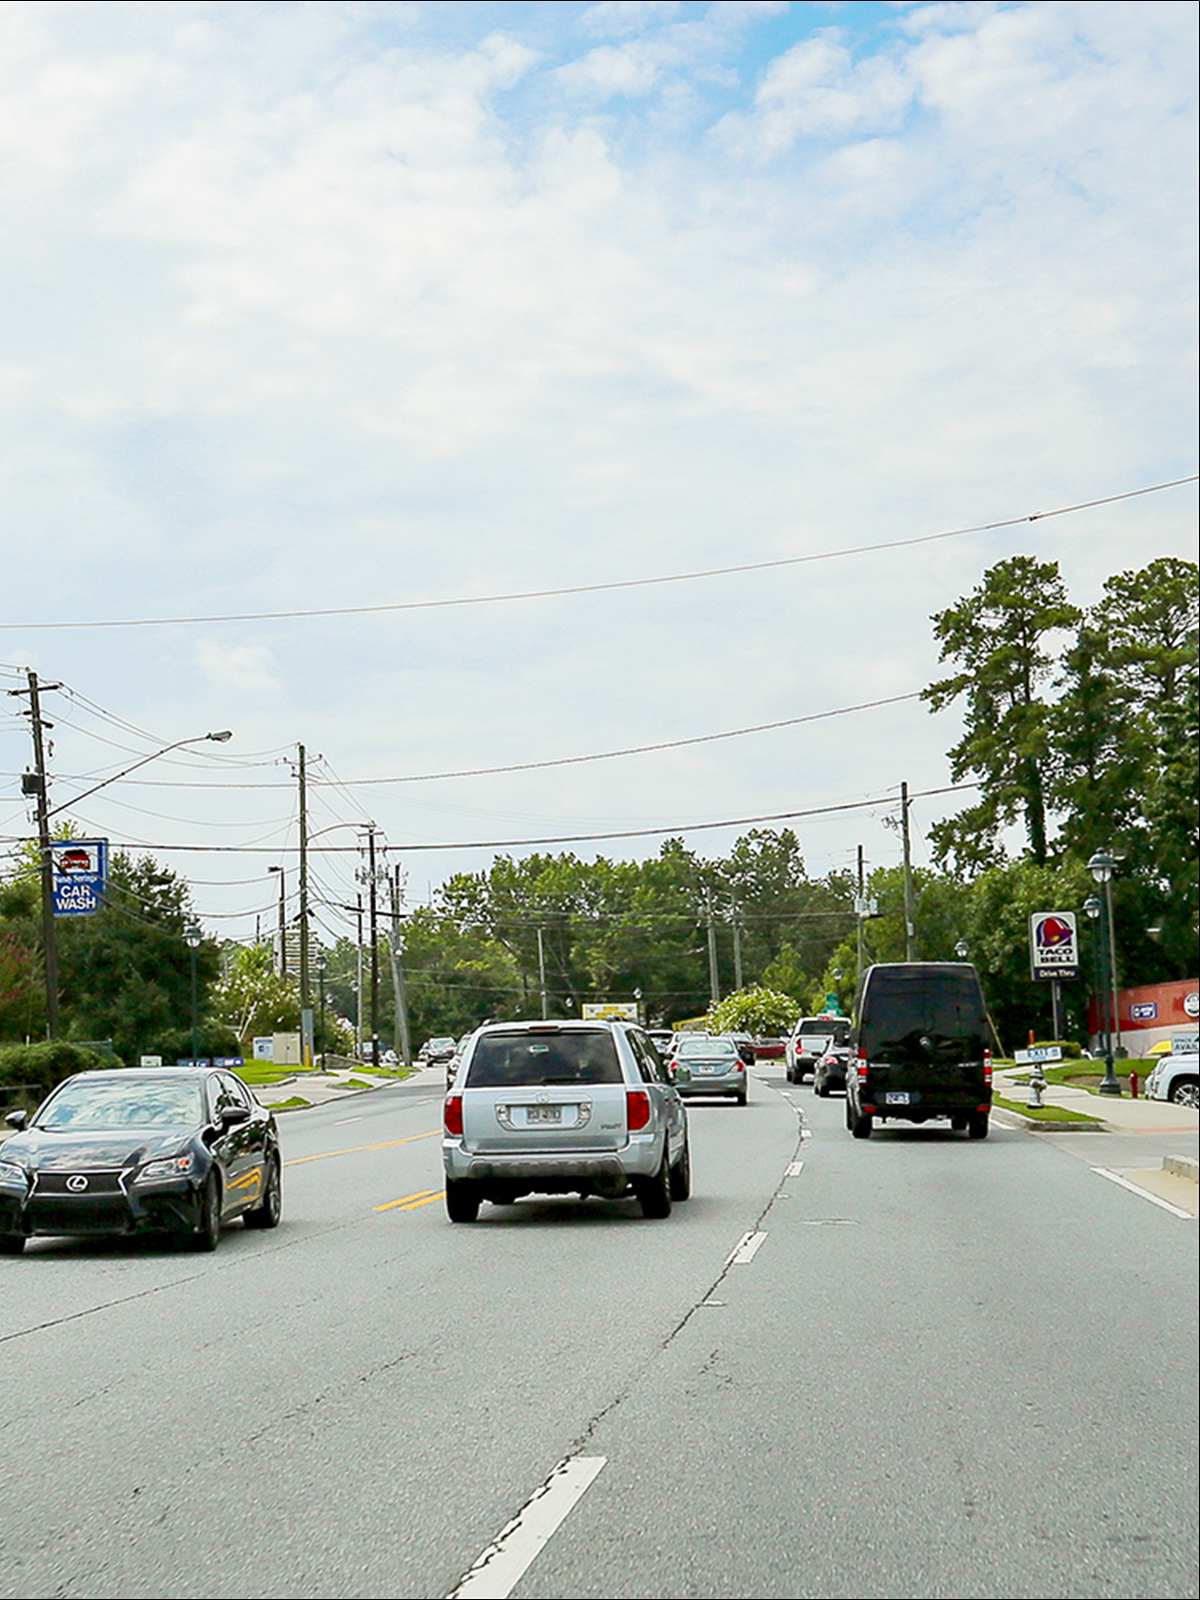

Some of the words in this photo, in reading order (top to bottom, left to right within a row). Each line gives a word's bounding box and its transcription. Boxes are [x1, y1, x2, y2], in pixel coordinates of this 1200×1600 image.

[60, 885, 91, 898] CAR
[55, 897, 96, 911] WASH
[1038, 947, 1074, 956] TACO
[1040, 955, 1075, 964] BELL
[1039, 969, 1058, 978] Drive
[1058, 969, 1076, 977] Thru
[1027, 1047, 1049, 1058] EXIT
